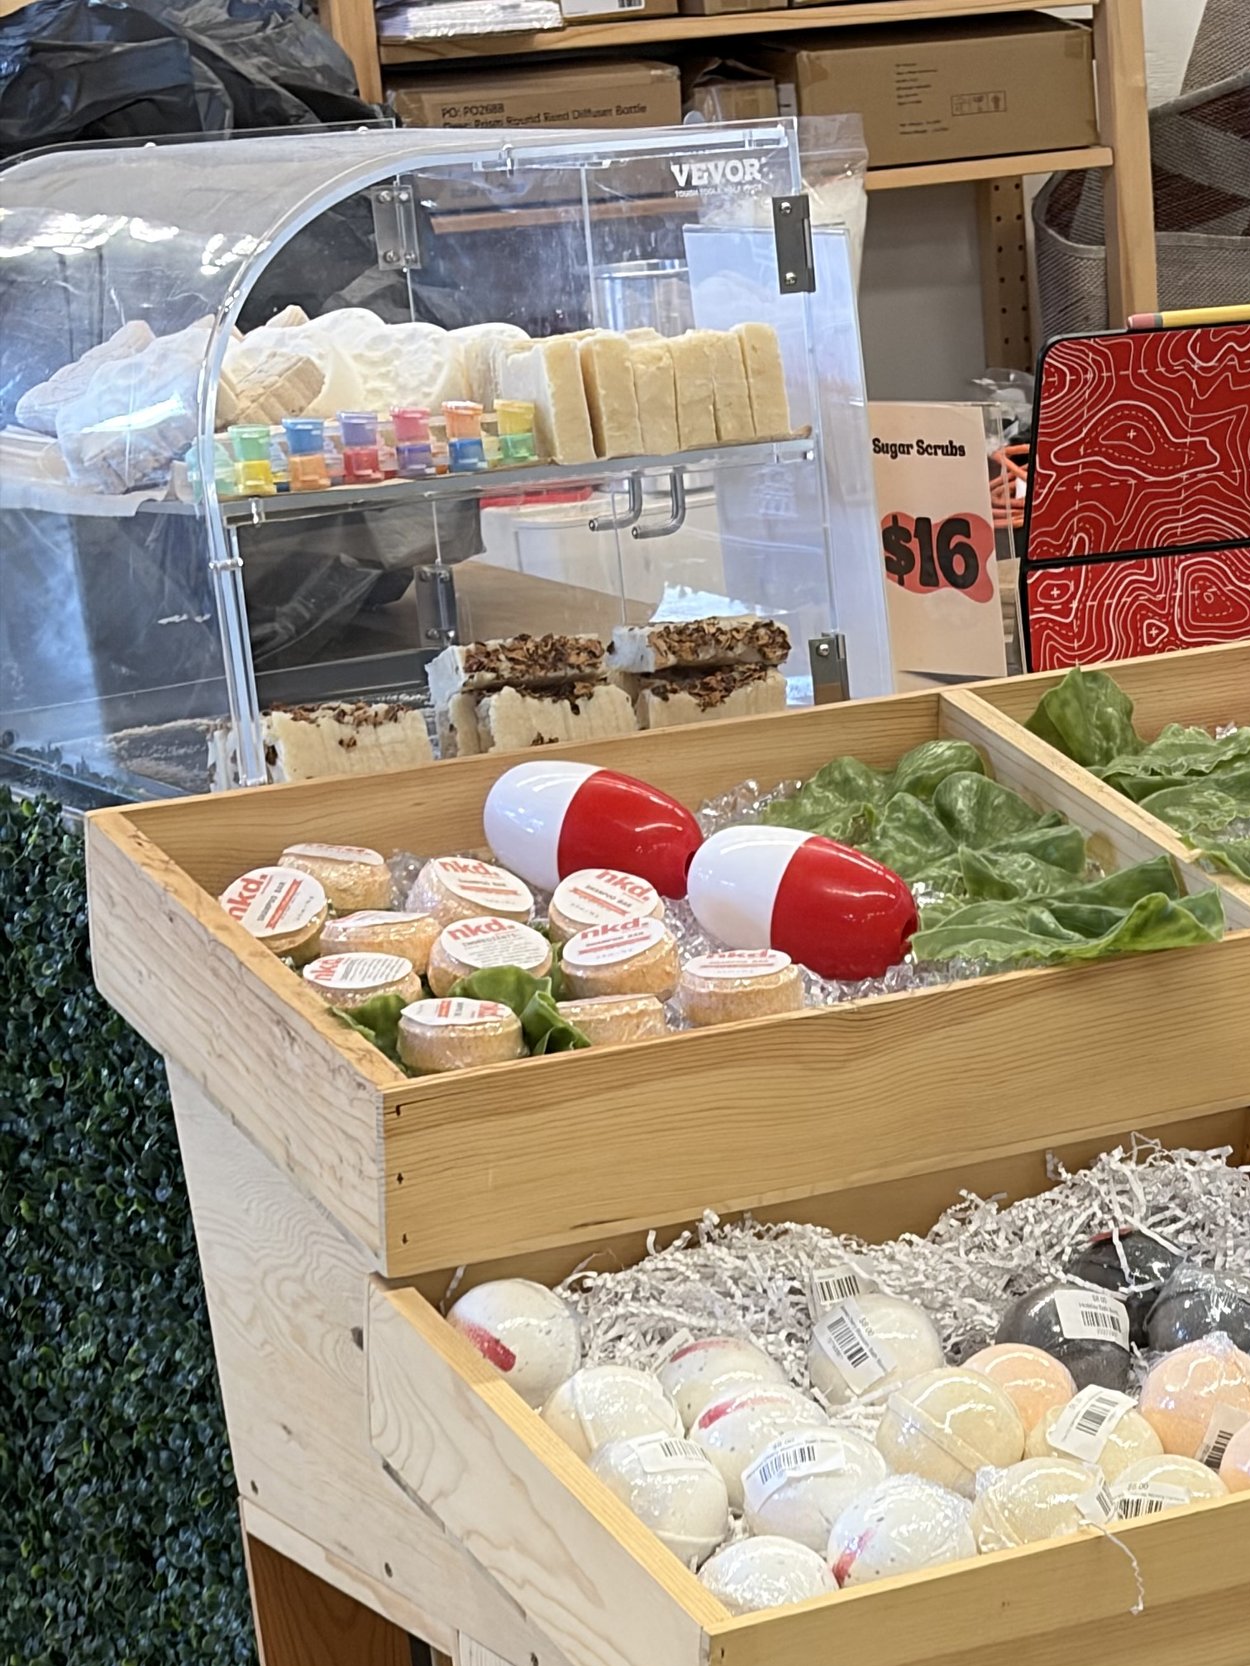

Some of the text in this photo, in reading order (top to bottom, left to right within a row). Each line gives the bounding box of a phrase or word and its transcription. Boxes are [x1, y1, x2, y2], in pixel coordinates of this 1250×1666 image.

[616, 103, 647, 115] Bottle
[670, 158, 761, 187] VEVOR
[872, 437, 966, 459] Sugar Scrubs
[882, 514, 979, 590] $16
[439, 861, 500, 877] nkd.
[595, 870, 653, 901] nkd.
[227, 874, 268, 921] nkd.
[447, 918, 516, 941] nkd.
[581, 917, 649, 939] nkd.
